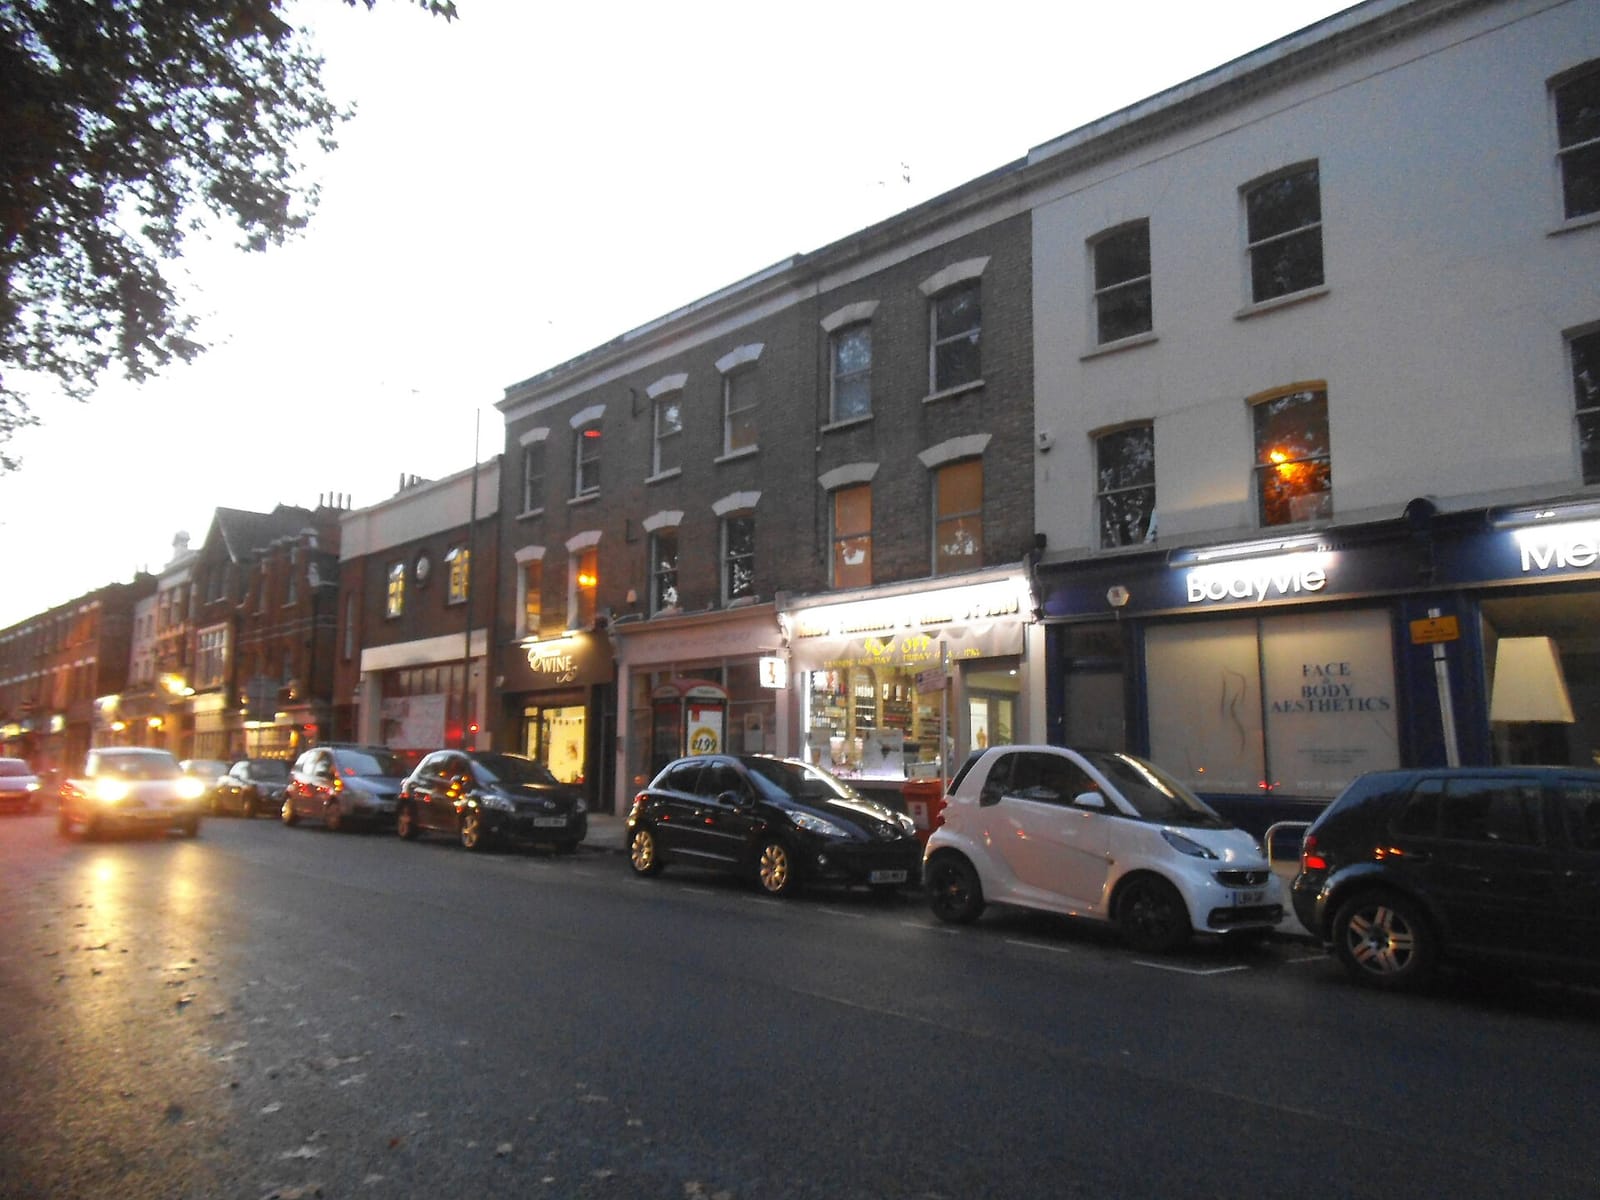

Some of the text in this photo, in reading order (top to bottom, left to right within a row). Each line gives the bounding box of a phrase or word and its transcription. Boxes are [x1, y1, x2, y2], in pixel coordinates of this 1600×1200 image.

[1186, 565, 1327, 603] Bodyvie
[541, 655, 572, 673] WINE
[1303, 662, 1351, 676] FACE
[1301, 683, 1352, 698] BODY
[1272, 695, 1391, 712] AESTHETICS
